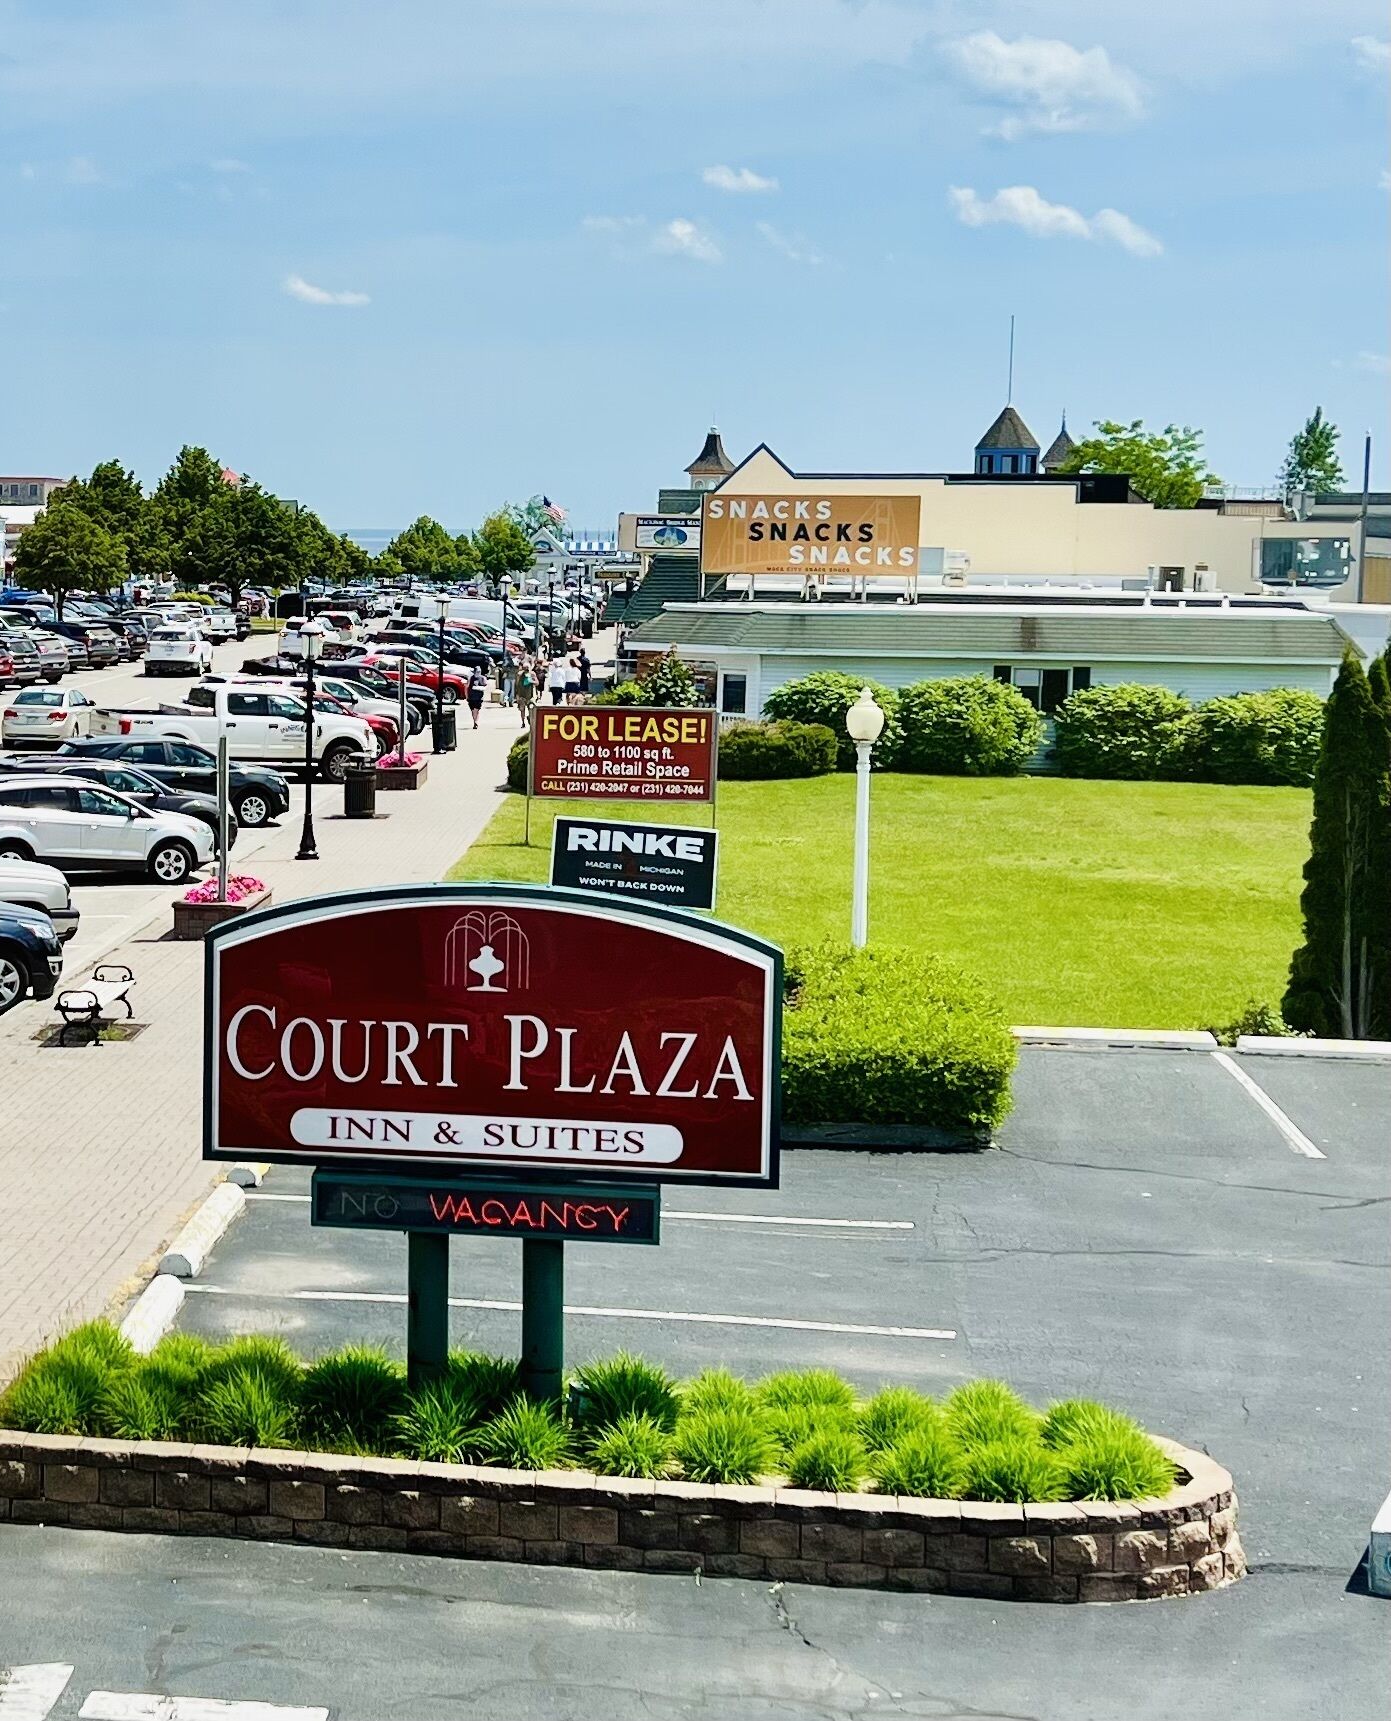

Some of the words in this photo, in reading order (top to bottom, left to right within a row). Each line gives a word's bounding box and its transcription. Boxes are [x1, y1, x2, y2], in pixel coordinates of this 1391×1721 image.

[708, 500, 832, 519] SNACKS
[748, 522, 874, 542] SNACKS
[789, 545, 914, 566] SNACKS
[543, 714, 600, 741] FOR
[608, 716, 707, 744] LEASE!
[573, 745, 595, 758] 580
[598, 746, 610, 758] to
[613, 746, 641, 759] 1100
[643, 749, 659, 762] sq
[662, 747, 674, 760] ft.
[558, 760, 598, 775] Prime
[602, 761, 642, 776] Retail
[646, 762, 690, 779] Space
[541, 781, 565, 791] CALL
[567, 781, 588, 793] (231)
[630, 785, 640, 793] or
[642, 783, 663, 795] (231)
[567, 827, 704, 863] RINKE
[585, 860, 606, 870] MADE
[608, 862, 622, 870] IN
[639, 865, 684, 876] MICHIGAN
[579, 876, 615, 887] WON'T
[617, 880, 647, 890] BACK
[650, 883, 685, 893] DOWN
[226, 1004, 469, 1088] COURT
[502, 1015, 755, 1101] PLAZA
[327, 1115, 413, 1143] INN
[433, 1120, 464, 1146] &
[483, 1123, 645, 1155] SUITES
[340, 1191, 398, 1219] NO
[430, 1193, 629, 1232] VACANCY
